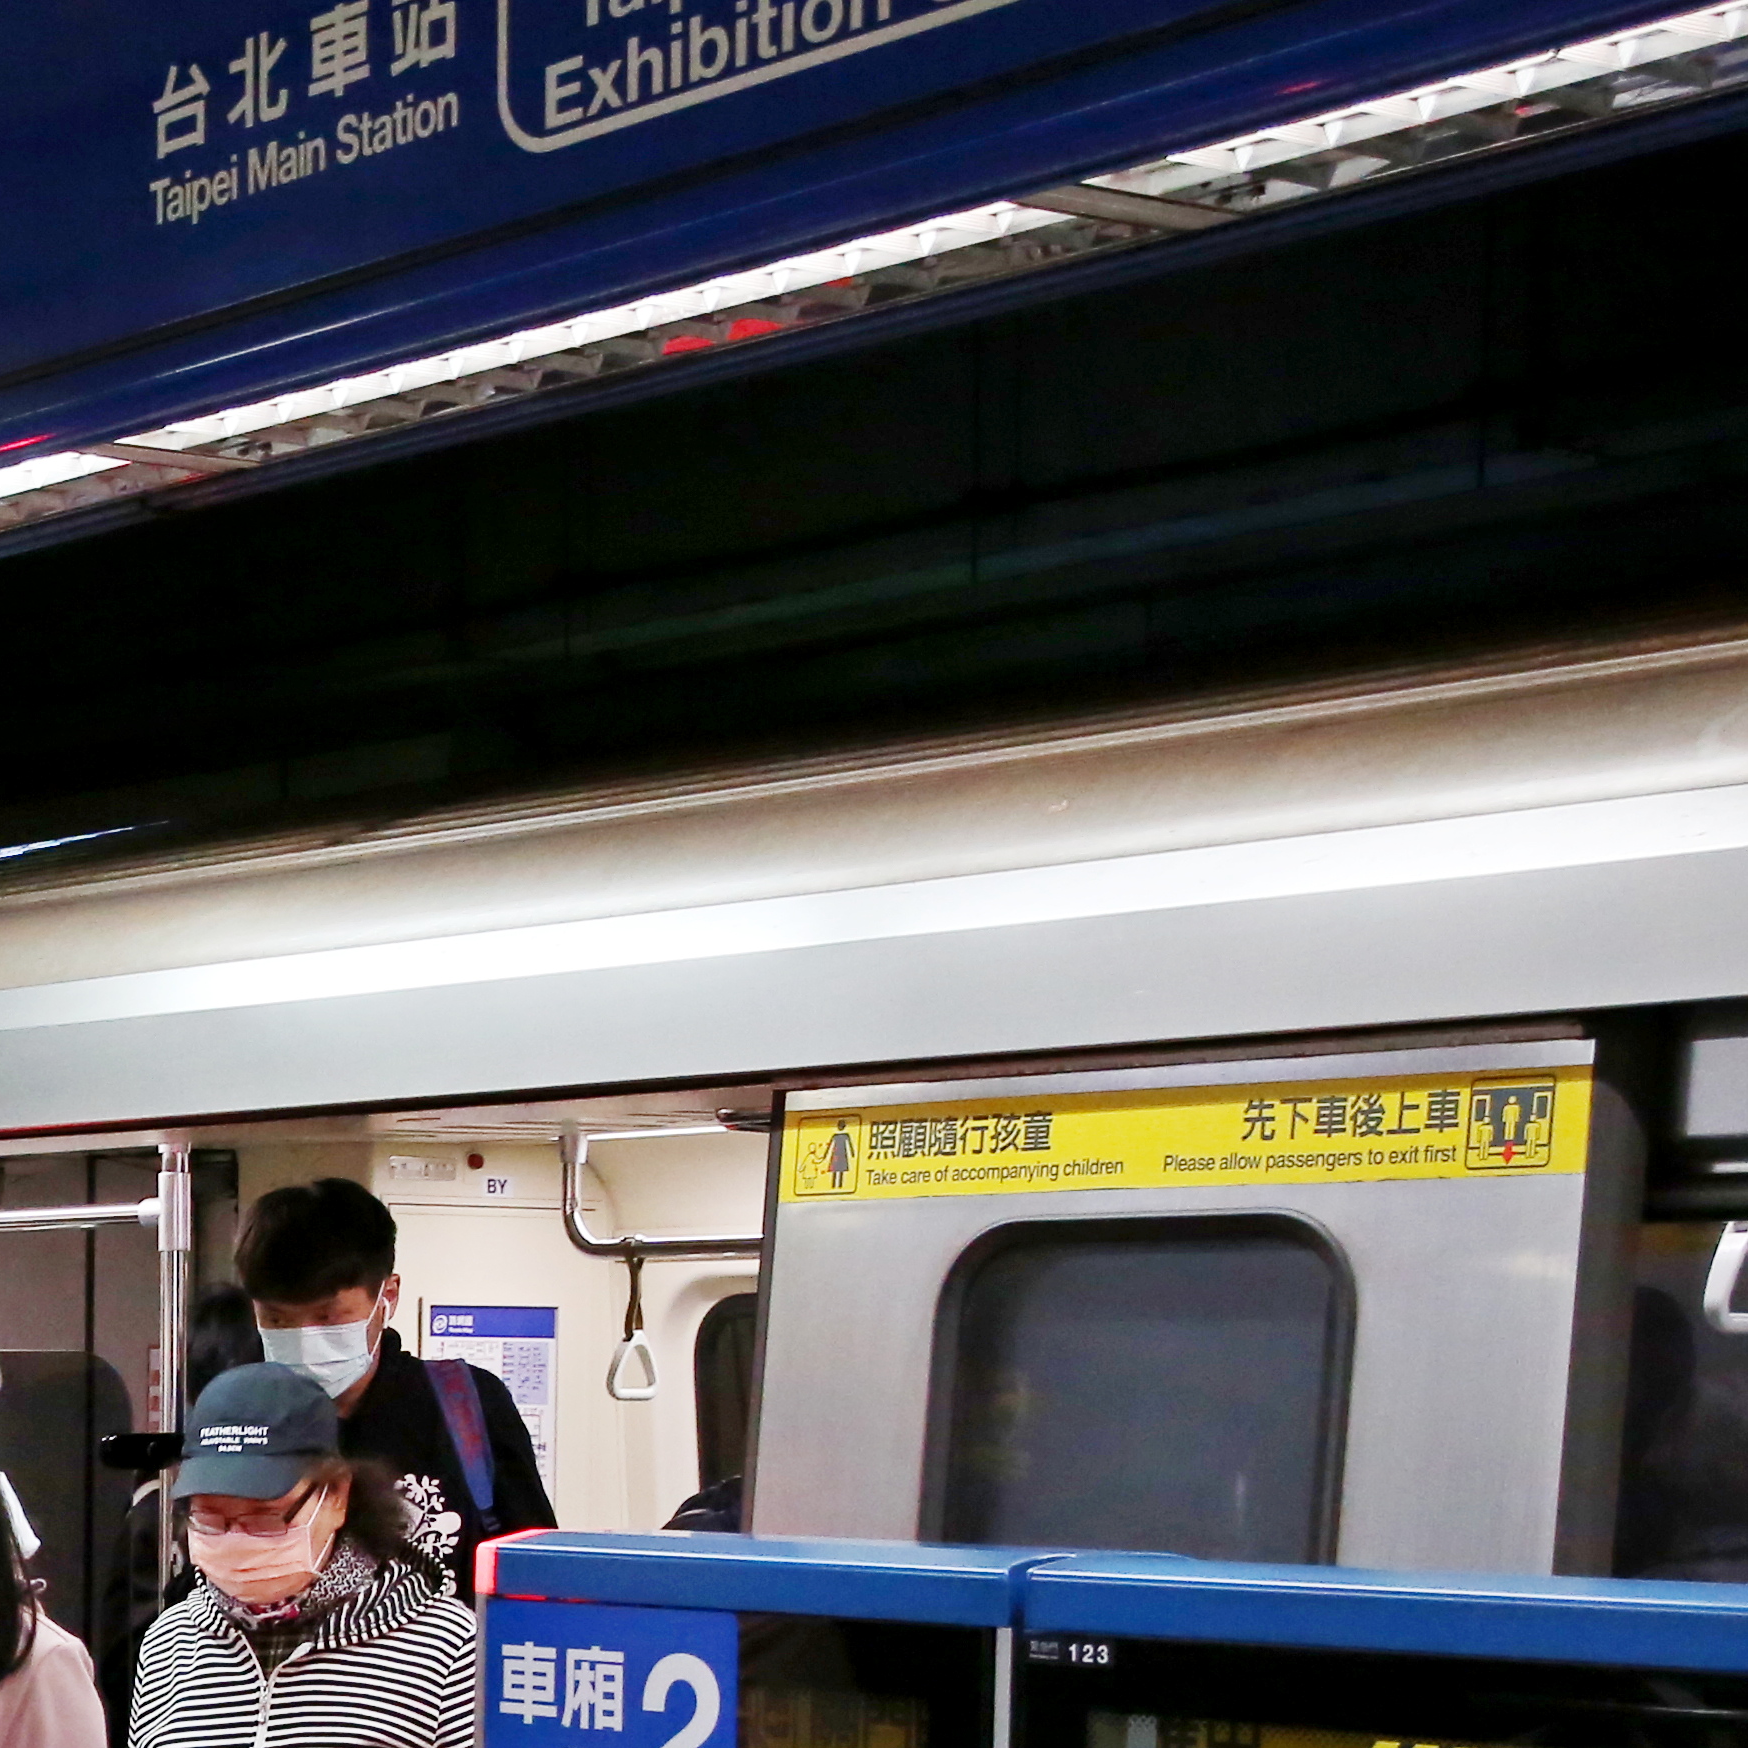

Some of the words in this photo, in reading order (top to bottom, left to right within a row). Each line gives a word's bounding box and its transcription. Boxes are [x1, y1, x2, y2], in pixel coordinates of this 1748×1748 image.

[152, 0, 456, 160] 台北車站
[149, 154, 238, 226] Taipei
[247, 131, 327, 196] Main
[335, 91, 460, 165] Station
[867, 1110, 1054, 1161] 照顧隨行孩童
[1240, 1089, 1461, 1142] 先下車後上車
[865, 1168, 897, 1187] Take
[900, 1168, 931, 1185] care
[934, 1165, 950, 1183] of
[951, 1160, 1059, 1185] accompanying
[1063, 1158, 1124, 1179] children
[1162, 1153, 1215, 1173] Please
[1219, 1151, 1262, 1171] allow
[1265, 1149, 1363, 1173] passengers
[1367, 1148, 1385, 1166] to
[1388, 1146, 1420, 1165] exit
[1423, 1144, 1457, 1163] first
[486, 1178, 508, 1195] BY
[1068, 1643, 1109, 1664] 123
[499, 1641, 625, 1732] 車廂
